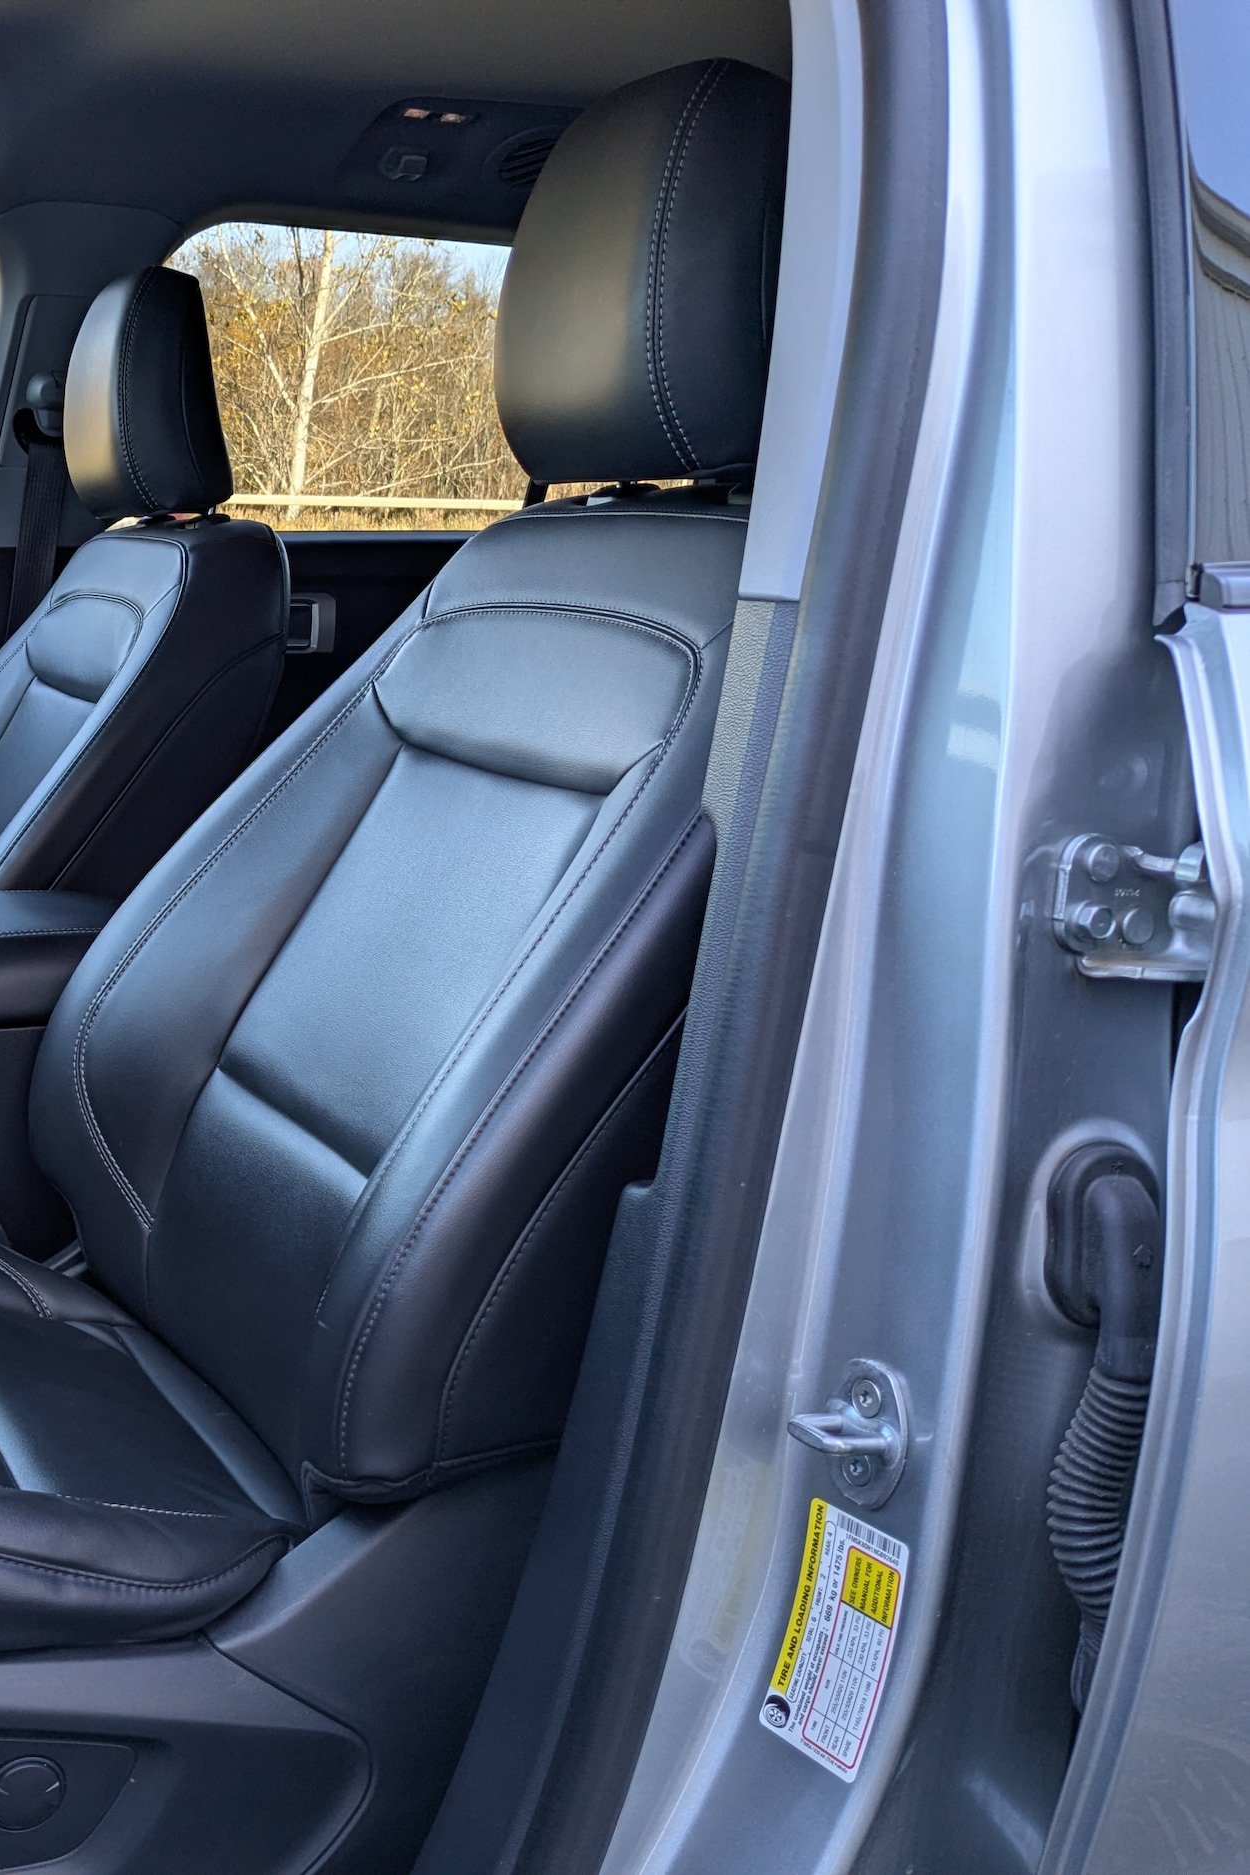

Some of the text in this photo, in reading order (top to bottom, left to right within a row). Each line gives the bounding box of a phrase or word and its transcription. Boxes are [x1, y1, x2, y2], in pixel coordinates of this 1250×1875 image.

[777, 1503, 824, 1688] TIRE AND LOADING INFORMATION
[820, 1572, 826, 1580] 2
[824, 1537, 845, 1622] 669 kg or 1475 lbs.
[851, 1556, 862, 1589] OWNERS
[859, 1561, 873, 1611] MANUAL FOR
[870, 1569, 883, 1615] ADDITIONAL
[881, 1570, 895, 1624] INFORMATION
[788, 1652, 807, 1700] SEATING CAPACITY
[788, 1630, 824, 1734] The combined weight of occupants
[797, 1633, 829, 1726] and cargo should never exceed
[821, 1724, 830, 1744] FRONT
[831, 1735, 840, 1751] REAR
[842, 1739, 852, 1758] SPARE
